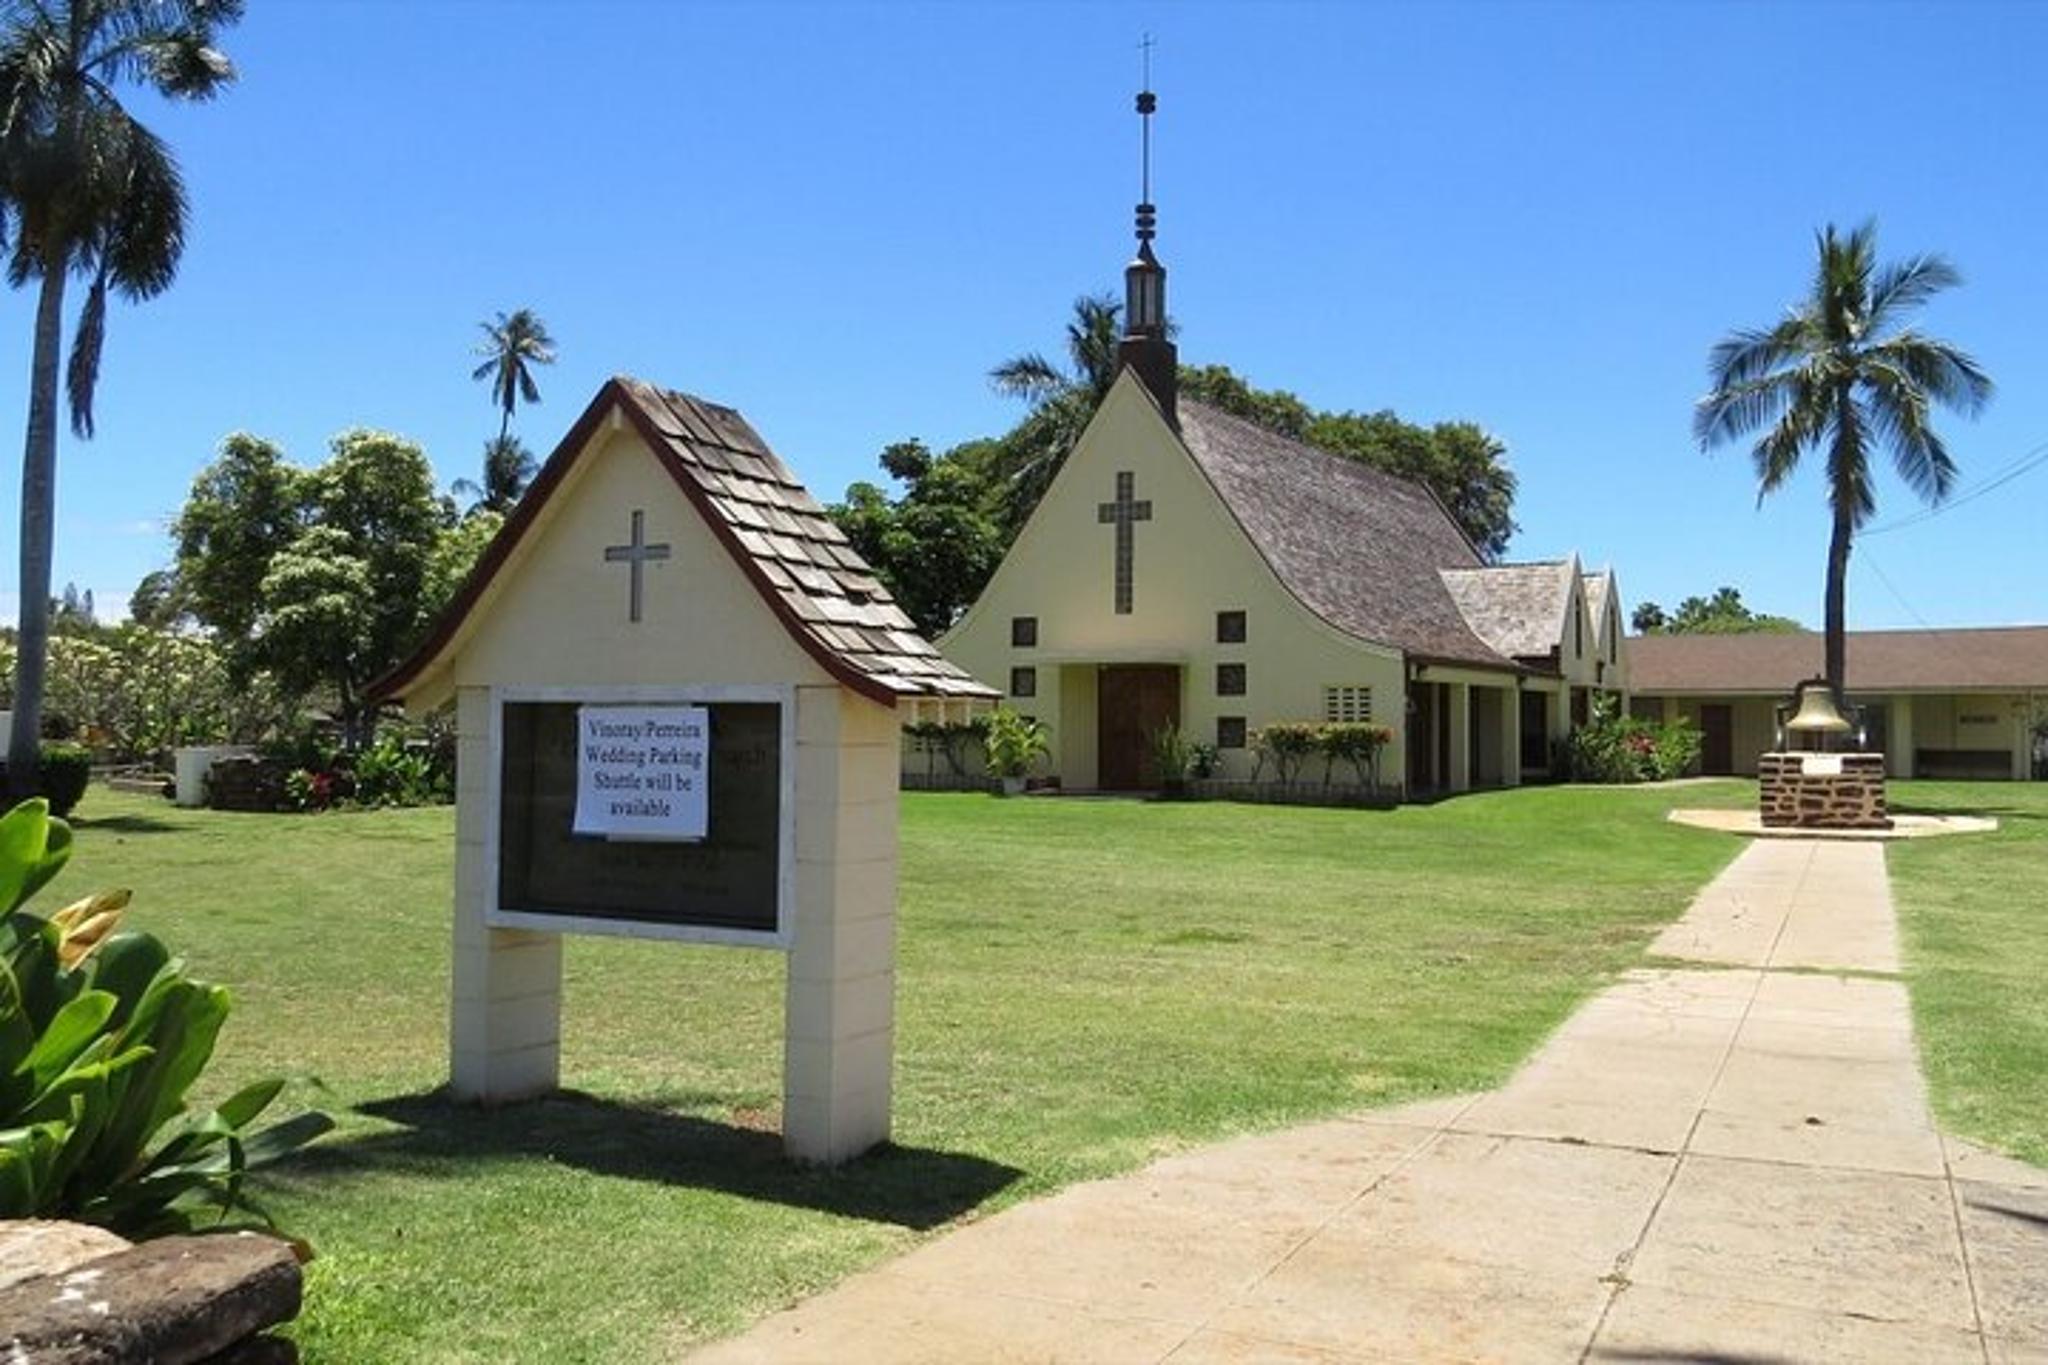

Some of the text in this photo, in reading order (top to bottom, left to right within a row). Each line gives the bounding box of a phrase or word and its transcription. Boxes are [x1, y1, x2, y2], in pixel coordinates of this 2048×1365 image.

[586, 747, 646, 768] Wedding
[650, 748, 702, 770] Parking
[593, 771, 692, 791] Shuttle will be
[611, 799, 670, 817] available
